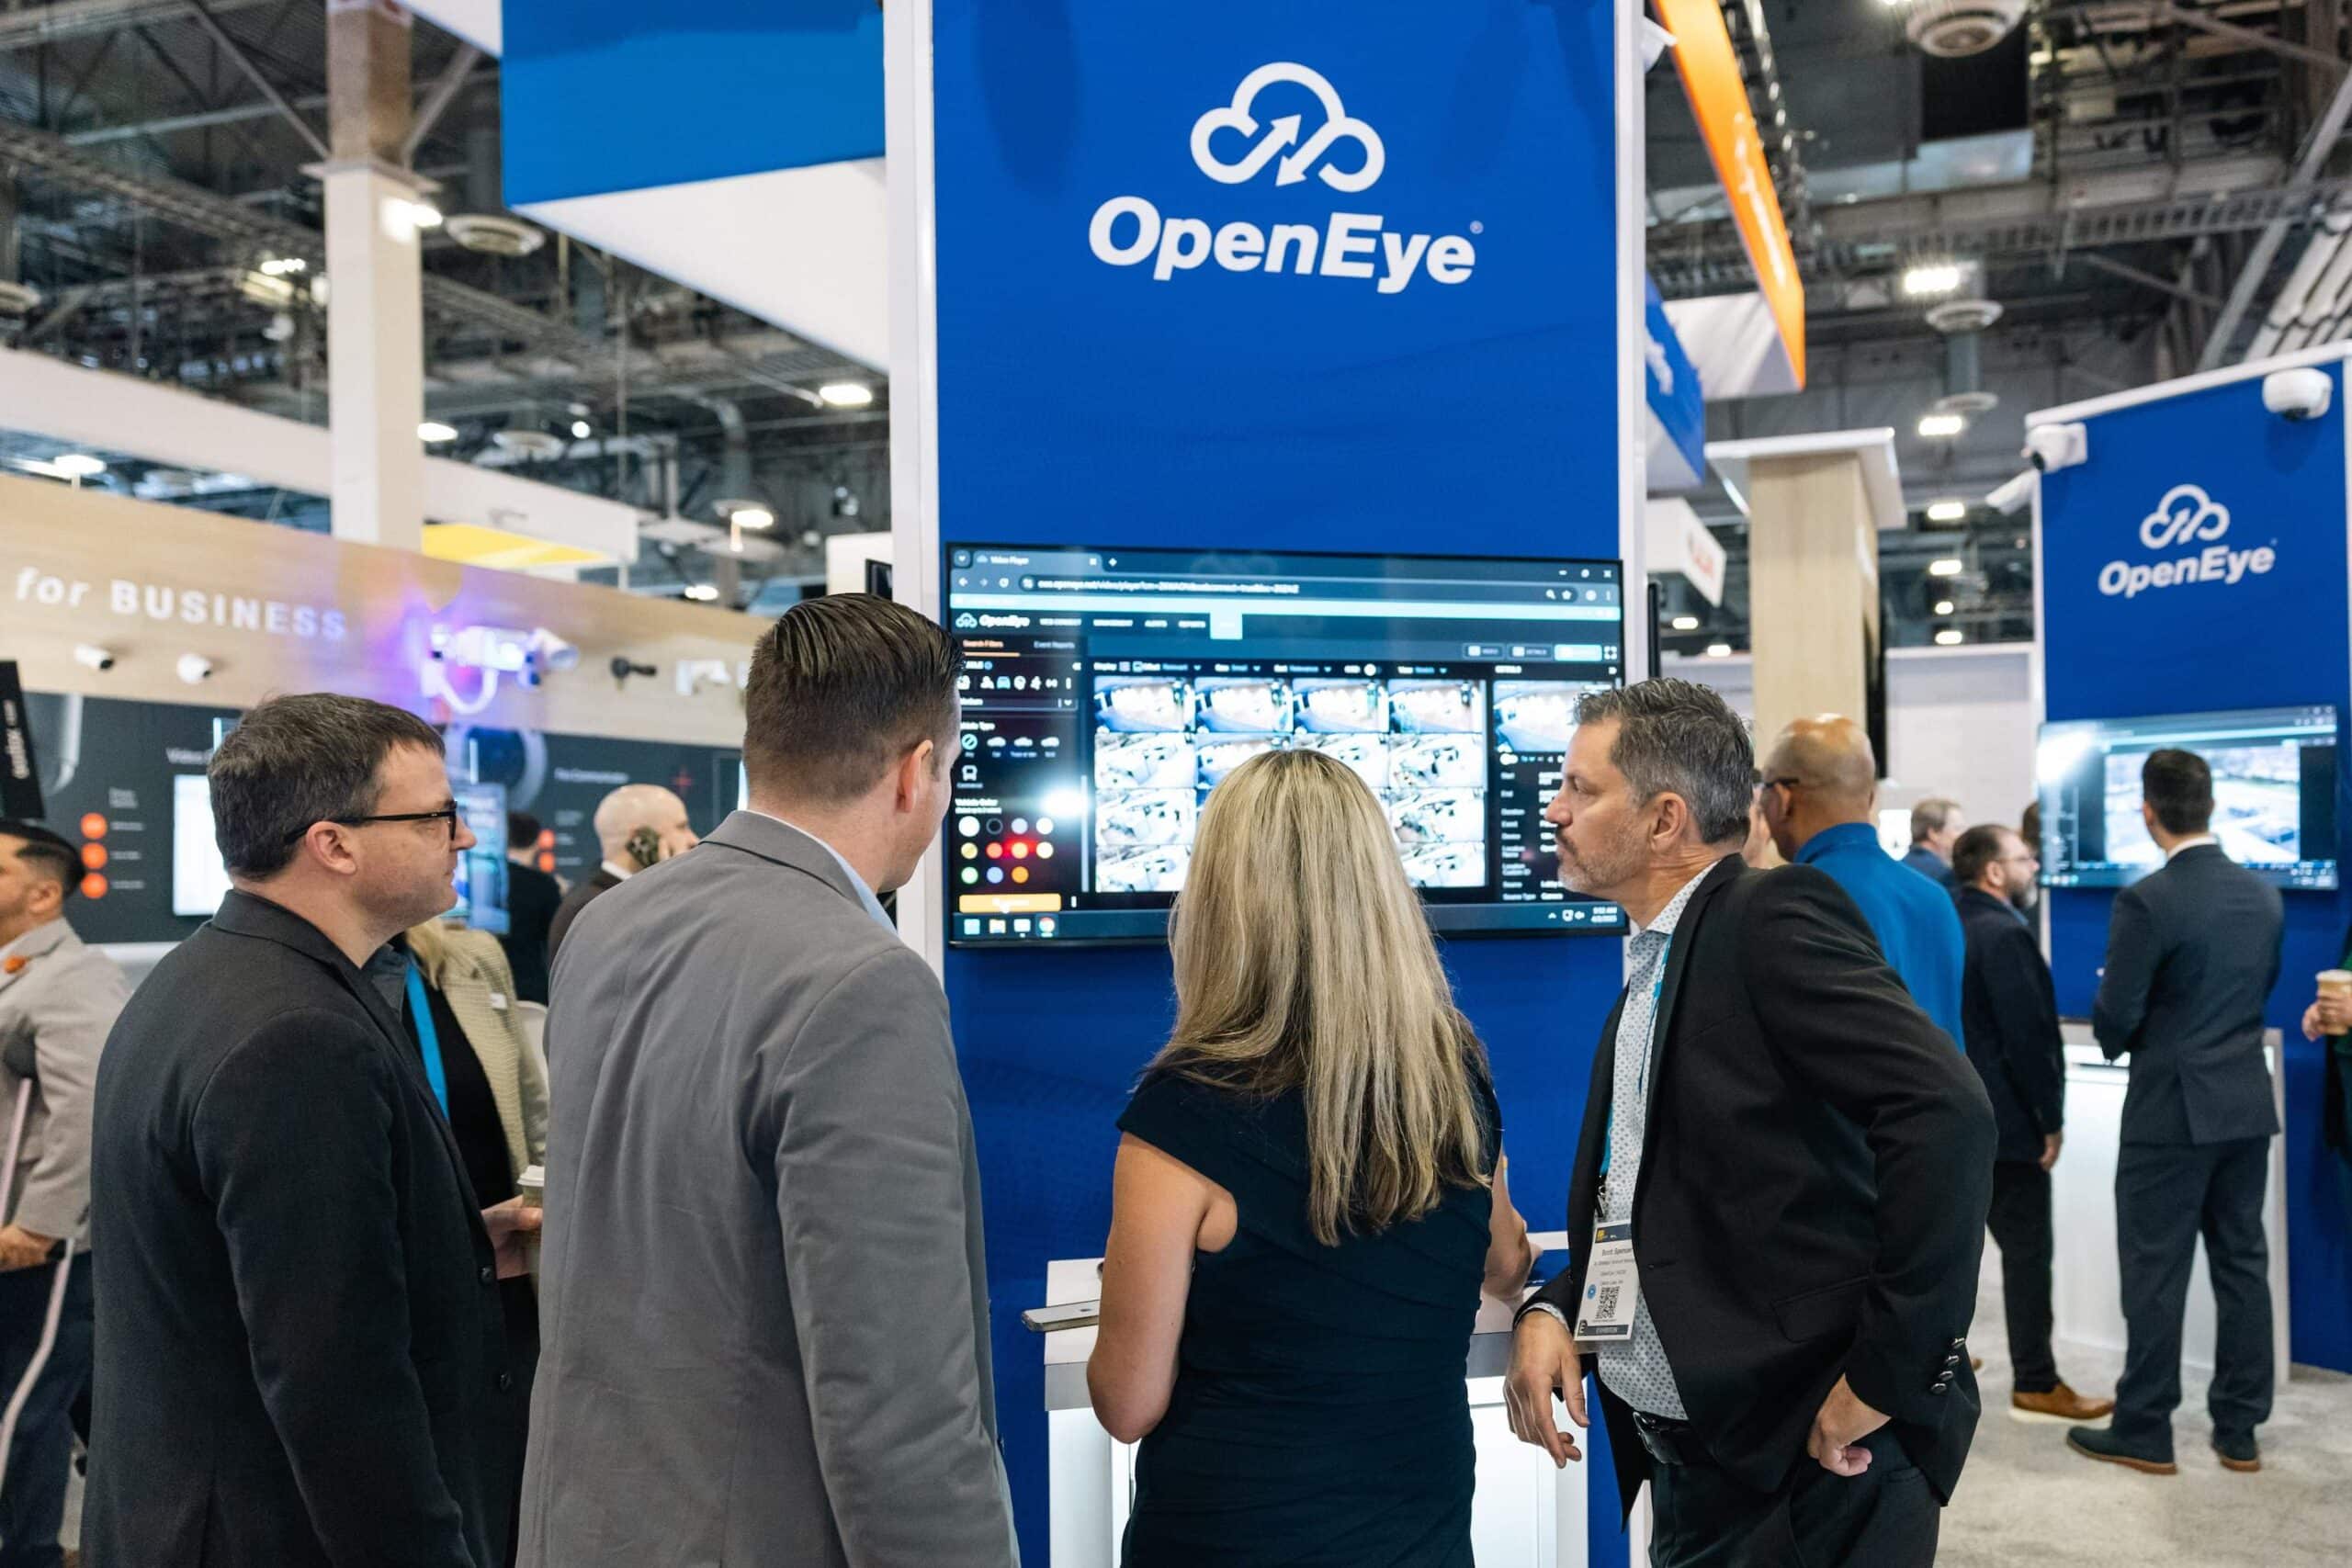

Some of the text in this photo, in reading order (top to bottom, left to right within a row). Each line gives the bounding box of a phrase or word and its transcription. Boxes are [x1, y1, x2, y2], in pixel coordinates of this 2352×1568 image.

[1088, 195, 1476, 294] OpenEye
[16, 566, 347, 640] for BUSINESS
[2098, 546, 2276, 598] OpenEye
